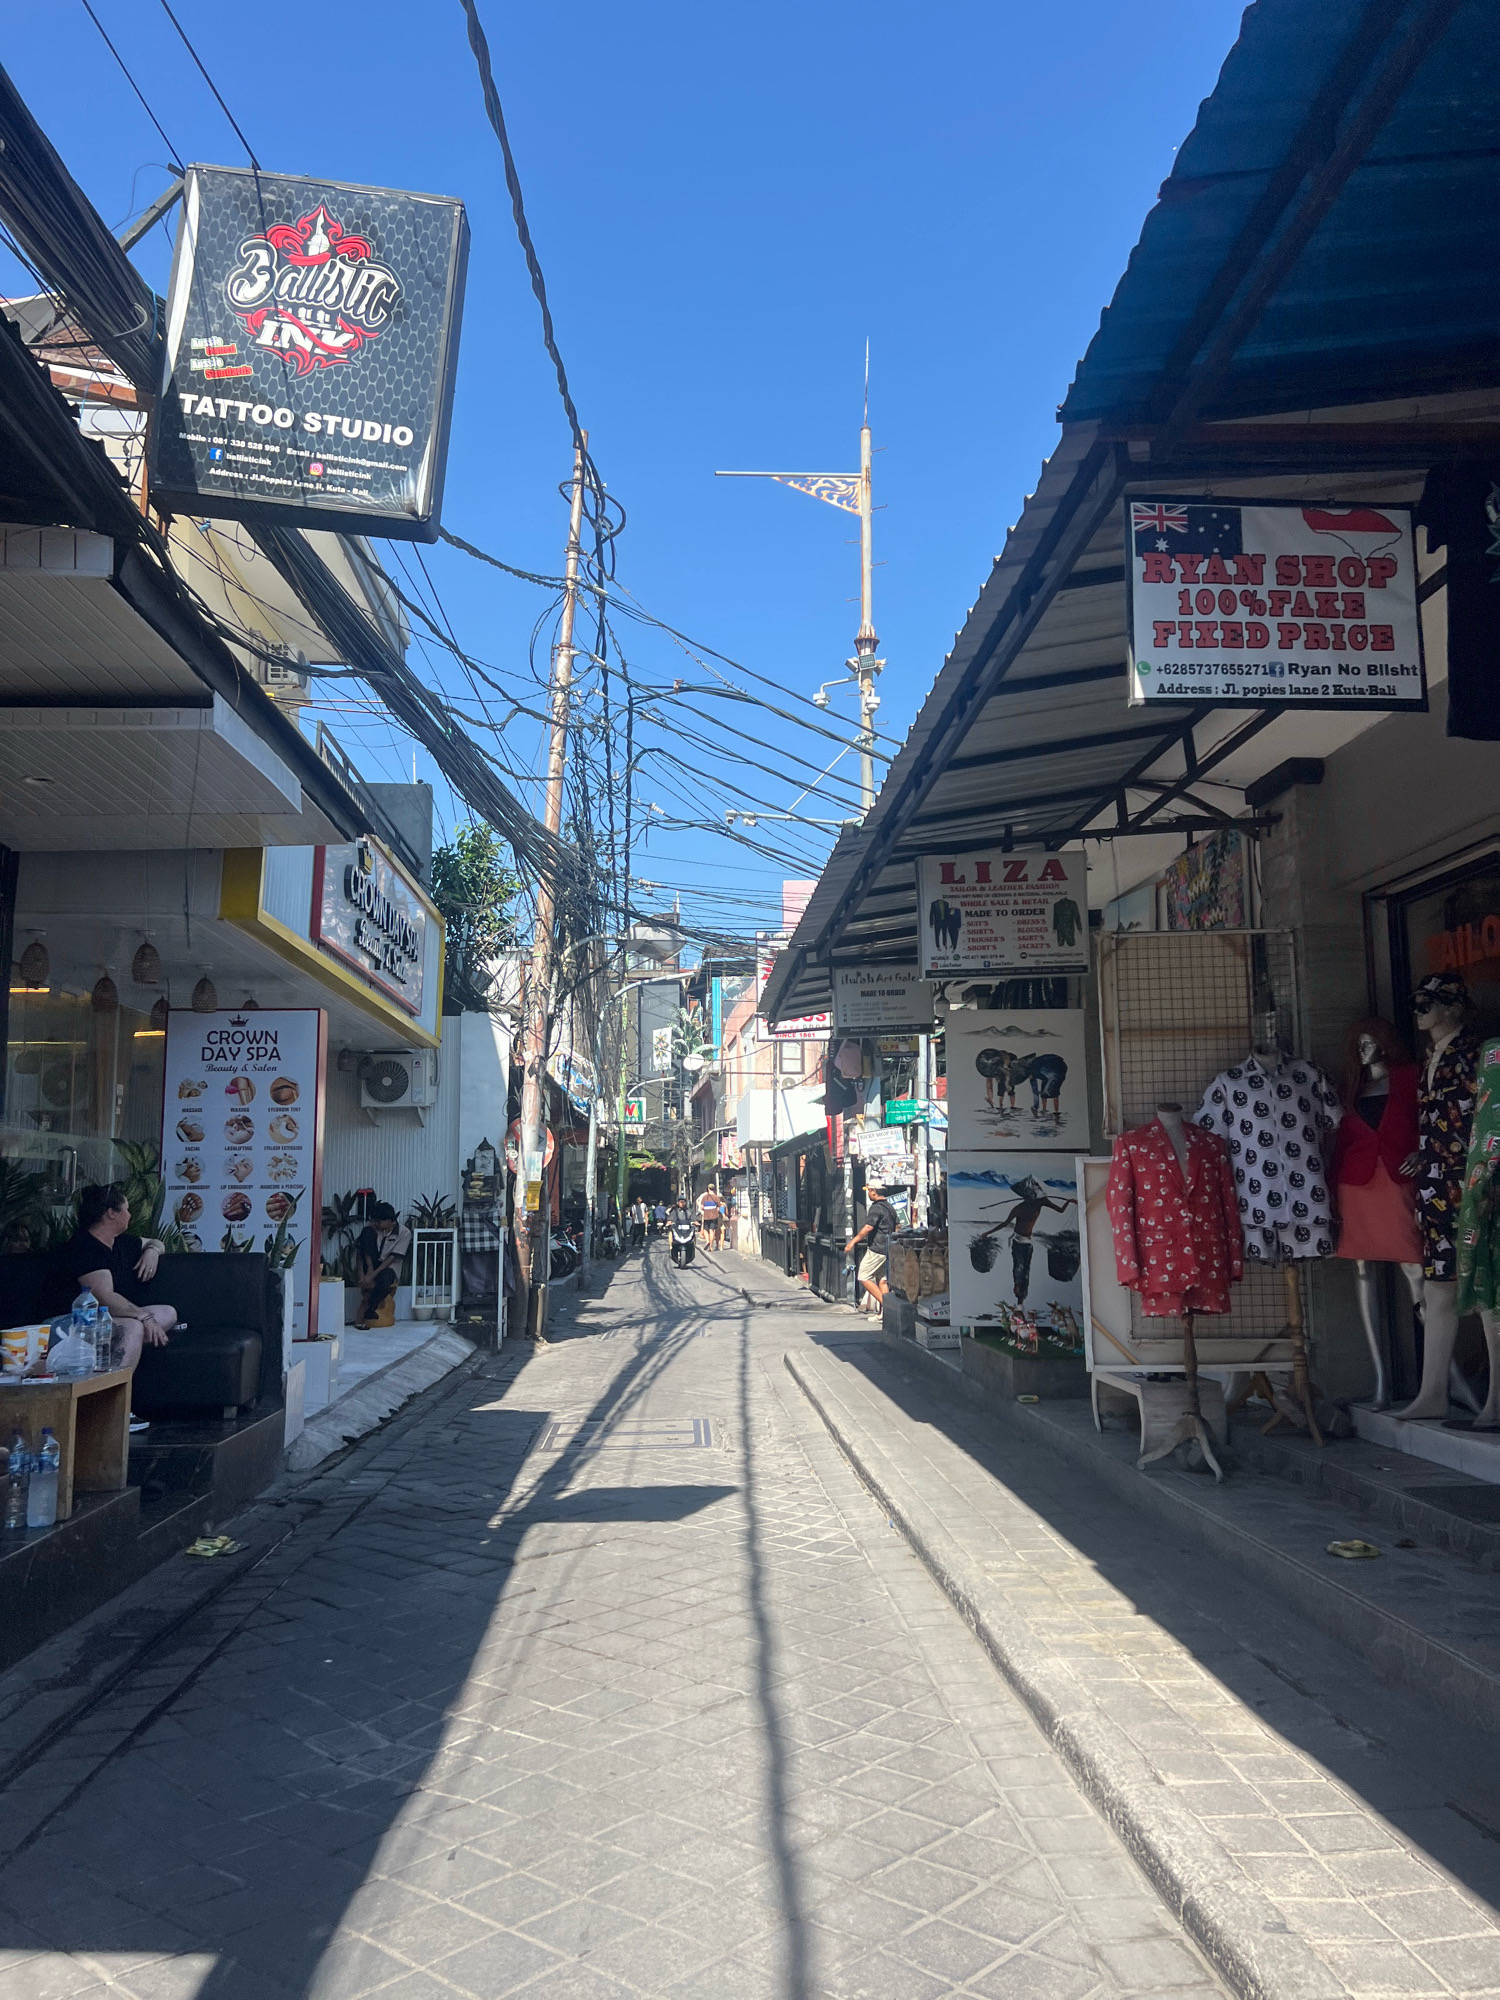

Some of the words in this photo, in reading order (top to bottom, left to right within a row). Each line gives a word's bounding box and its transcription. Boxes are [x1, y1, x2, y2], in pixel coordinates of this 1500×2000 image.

[228, 239, 400, 327] Ballistic
[255, 319, 355, 359] INK
[179, 392, 295, 428] TATTOO
[303, 411, 414, 446] STUDIO
[179, 432, 207, 442] Mobile
[213, 437, 228, 445] 081
[230, 439, 246, 448] 338
[247, 441, 263, 450] 528
[265, 444, 280, 453] 996
[286, 447, 311, 457] Email
[316, 451, 408, 472] ballisticink@gmail.com
[226, 453, 272, 466] ballisticink
[209, 467, 244, 479] Address
[326, 484, 346, 494] Kuta
[352, 487, 369, 496] Bali
[327, 467, 372, 480] ballisticink
[1141, 552, 1266, 585] RYAN
[1275, 554, 1398, 589] SHOP
[1152, 620, 1270, 649] FIXED
[1277, 622, 1395, 652] PRICE
[1156, 662, 1269, 677] +6285737655271
[1288, 661, 1332, 677] Ryan
[1337, 663, 1362, 677] No
[1157, 683, 1212, 696] Address
[1242, 684, 1287, 698] popies
[1288, 684, 1319, 696] lane
[1321, 685, 1330, 695] 2
[965, 909, 992, 918] MADE
[996, 909, 1008, 917] TO
[1011, 908, 1046, 917] ORDER
[876, 972, 893, 982] Art
[206, 1030, 279, 1045] CROWN
[201, 1046, 245, 1062] DAY
[246, 1046, 282, 1062] SPA
[204, 1064, 238, 1075] Beauty
[241, 1064, 248, 1072] &
[251, 1064, 278, 1072] Salon
